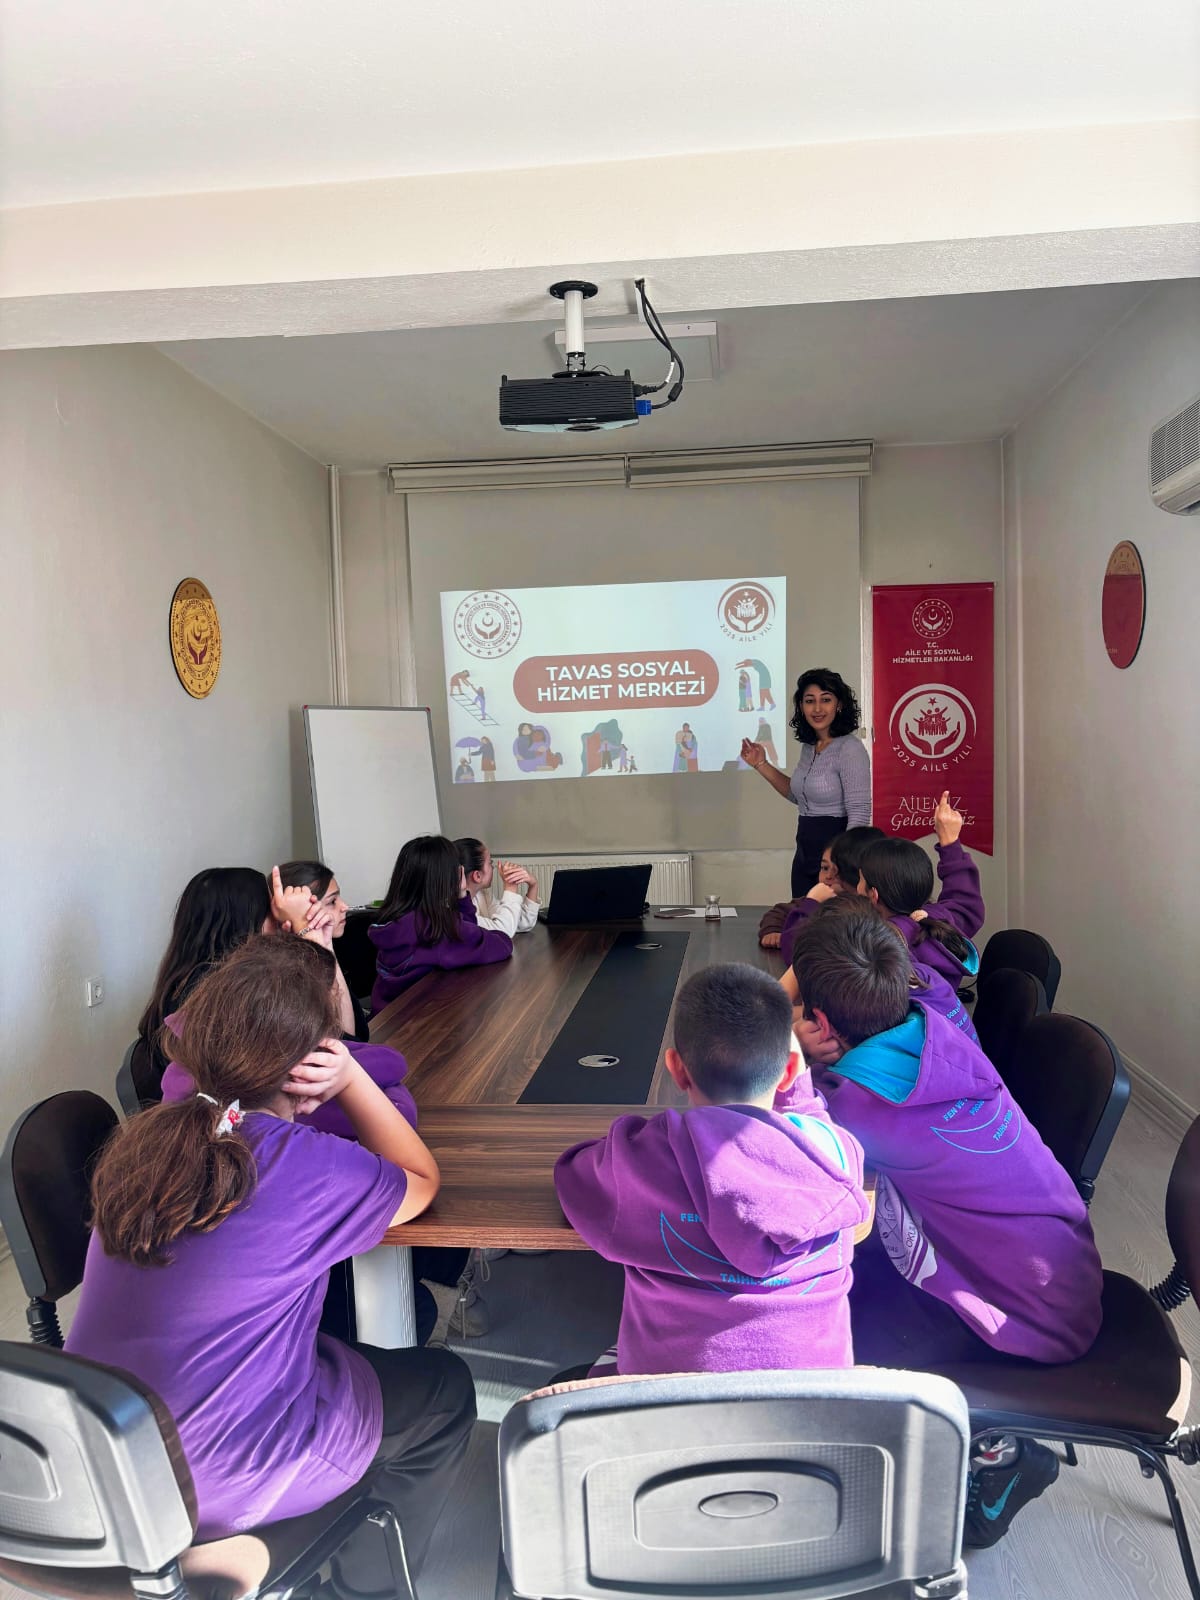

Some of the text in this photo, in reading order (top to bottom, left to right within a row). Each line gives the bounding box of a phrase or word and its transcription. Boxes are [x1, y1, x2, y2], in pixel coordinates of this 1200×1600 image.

[892, 653, 974, 664] HİZMETLER BAKANLIĞI
[905, 648, 921, 657] AİLE
[545, 660, 695, 682] TAVAS SOSYAL
[537, 676, 705, 702] HİZMET MERKEZİ
[892, 744, 973, 772] 2025 AİLE YILI
